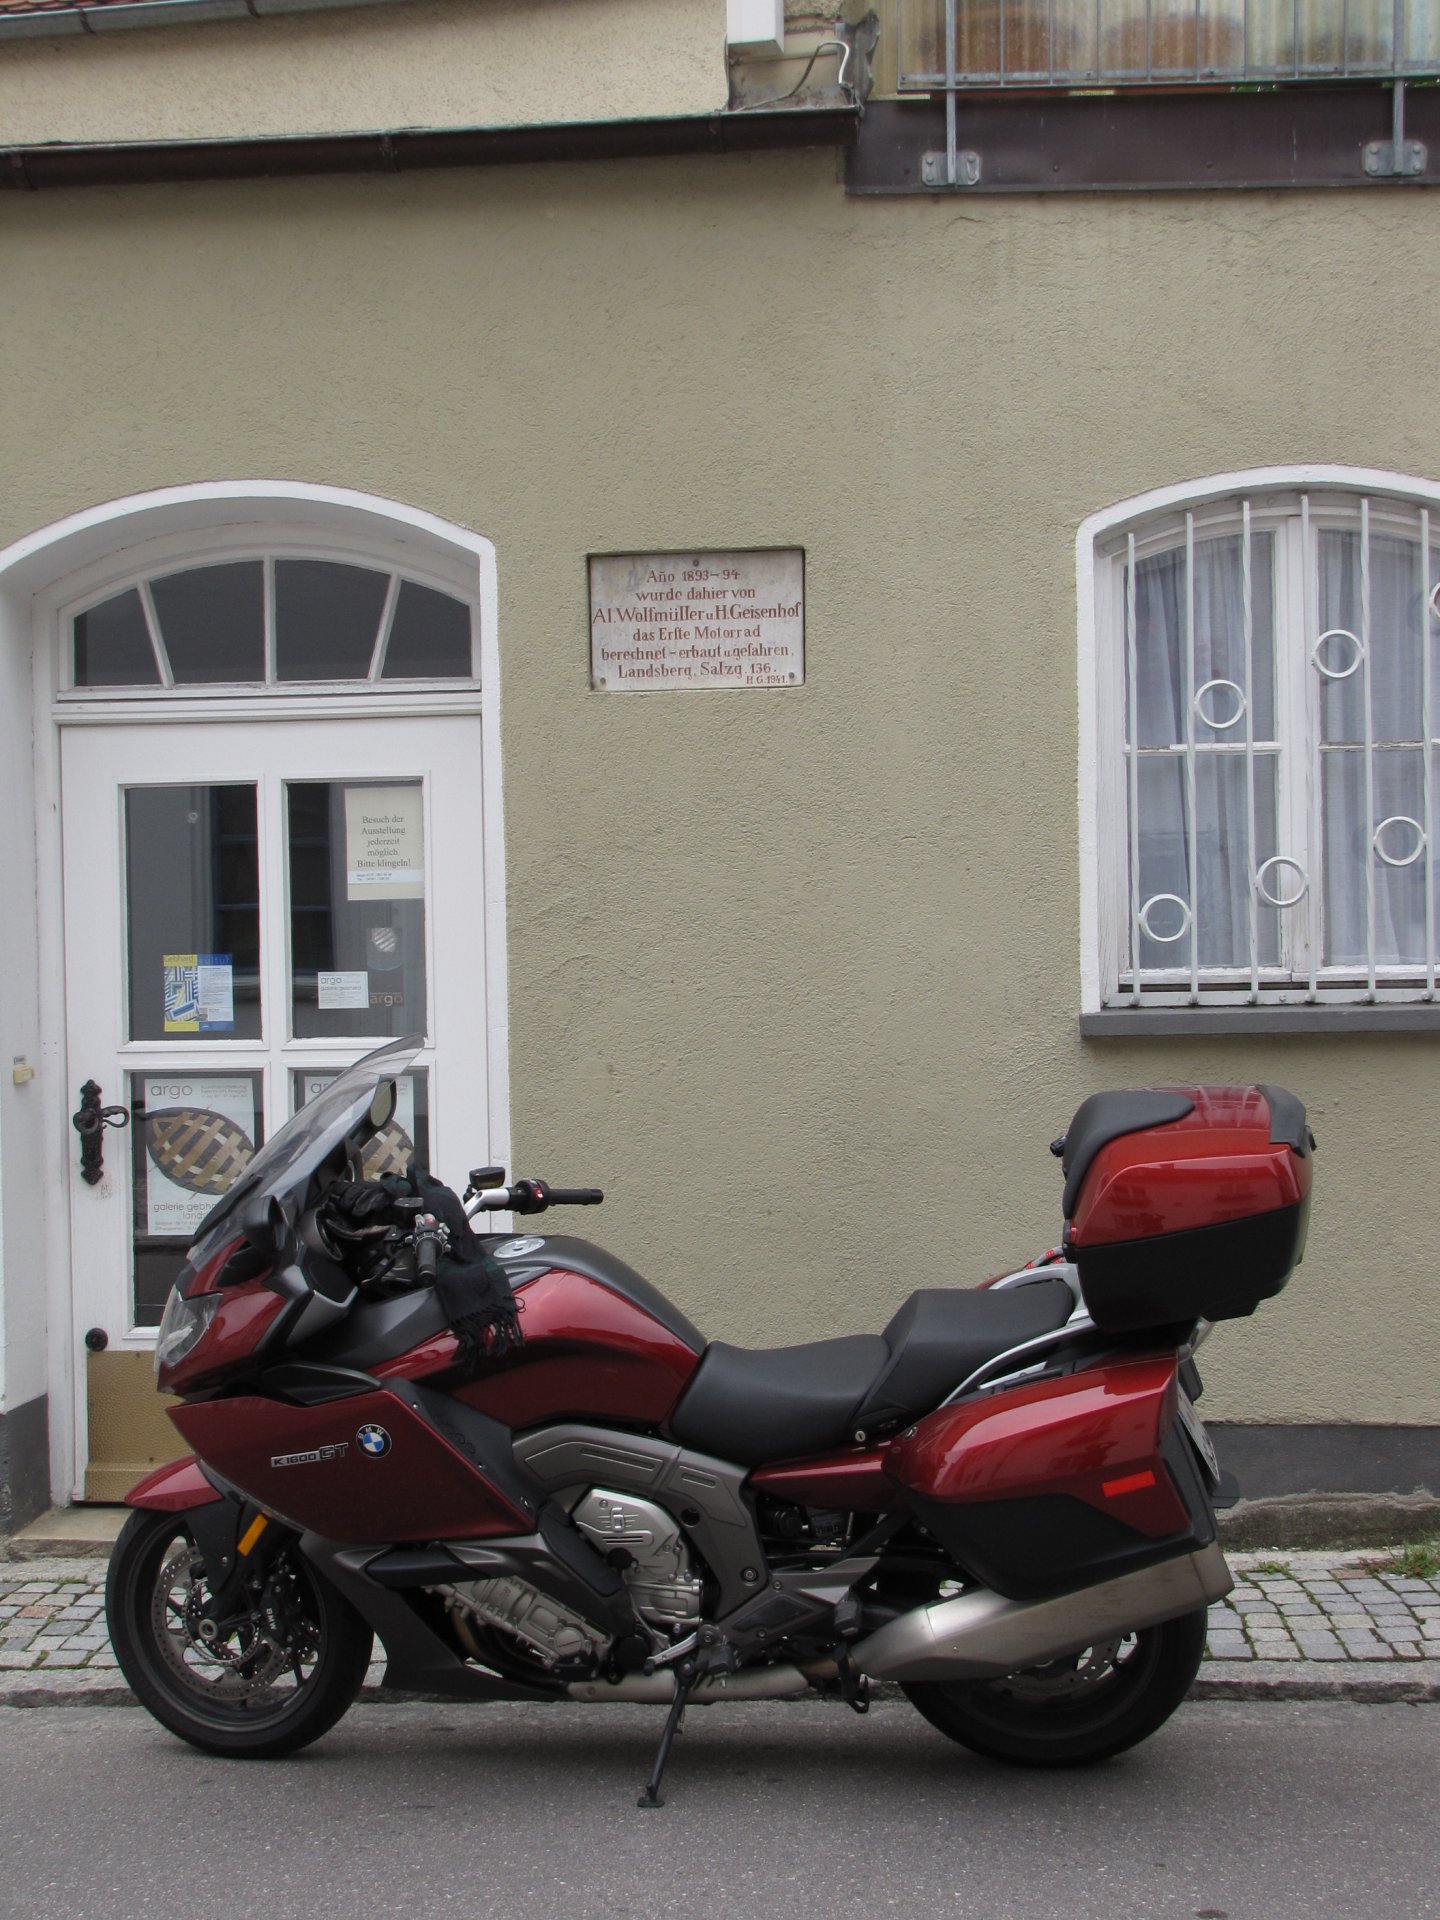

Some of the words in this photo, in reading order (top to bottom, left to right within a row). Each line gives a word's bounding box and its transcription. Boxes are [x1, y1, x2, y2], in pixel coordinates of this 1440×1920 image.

[635, 588, 682, 601] wurde
[687, 587, 729, 600] dahier
[731, 588, 756, 599] von
[730, 602, 802, 620] Geisenhof
[633, 628, 655, 642] das
[694, 624, 761, 640] Motorrad
[601, 647, 666, 661] berechnet
[679, 644, 721, 659] erbaut
[362, 816, 390, 824] Besuch
[391, 815, 404, 823] der
[361, 826, 406, 835] Ausstellung
[367, 838, 400, 847] jederzeit
[357, 860, 375, 868] Bitte
[320, 977, 342, 985] argo
[150, 1084, 193, 1099] argo
[153, 1202, 185, 1213] galerie
